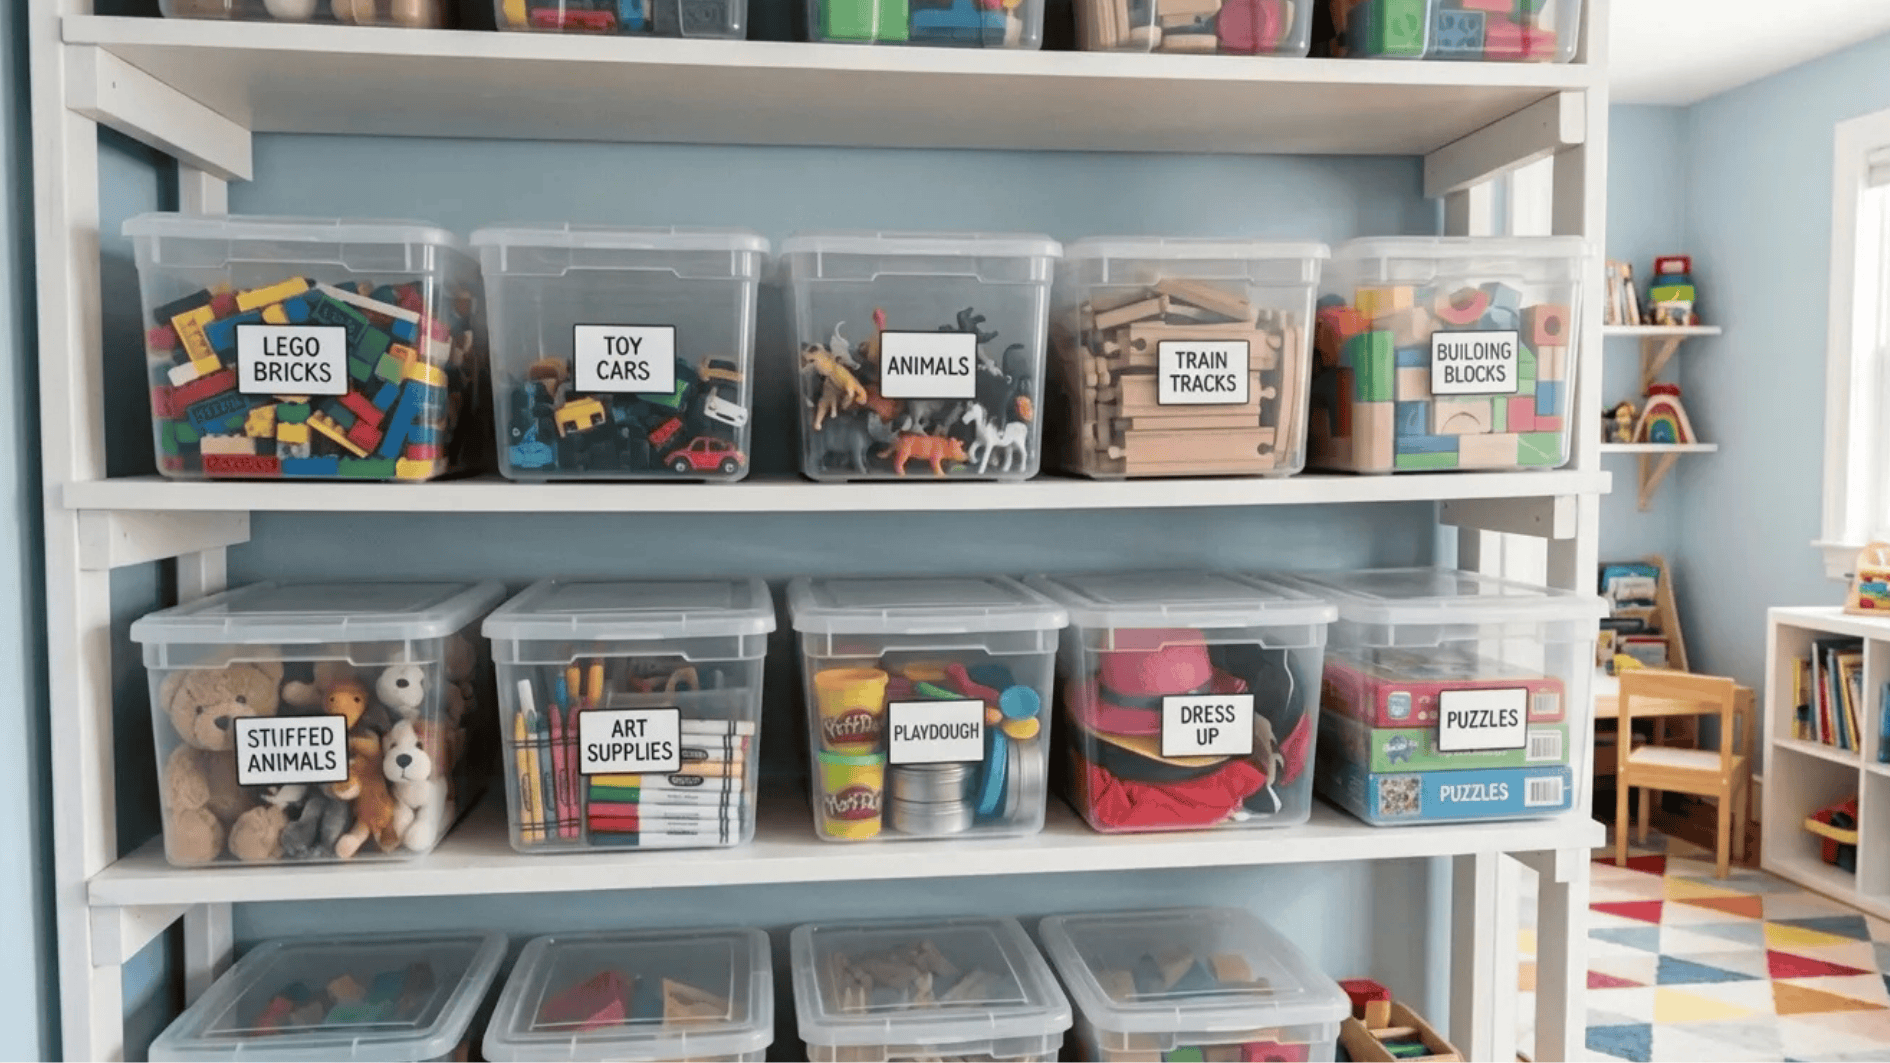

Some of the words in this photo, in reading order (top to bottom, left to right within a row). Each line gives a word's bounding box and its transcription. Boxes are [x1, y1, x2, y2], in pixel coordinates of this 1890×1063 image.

[263, 335, 321, 358] LEGO
[603, 335, 643, 356] TOY
[596, 359, 651, 381] CARS
[887, 355, 971, 377] ANIMALS
[1174, 350, 1228, 370] TRAIN
[253, 360, 332, 383] BRICKS
[1444, 364, 1507, 384] BLOCKS
[1169, 373, 1237, 393] TRACKS
[1180, 704, 1236, 725] DRESS
[1447, 708, 1519, 729] PUZZLES
[611, 718, 648, 739] ART
[894, 721, 979, 742] PLAYDOUGH
[1196, 727, 1220, 746] UP
[247, 749, 337, 773] ANIMALS
[587, 740, 673, 763] SUPPLIES
[1439, 782, 1510, 802] PUZZLES
